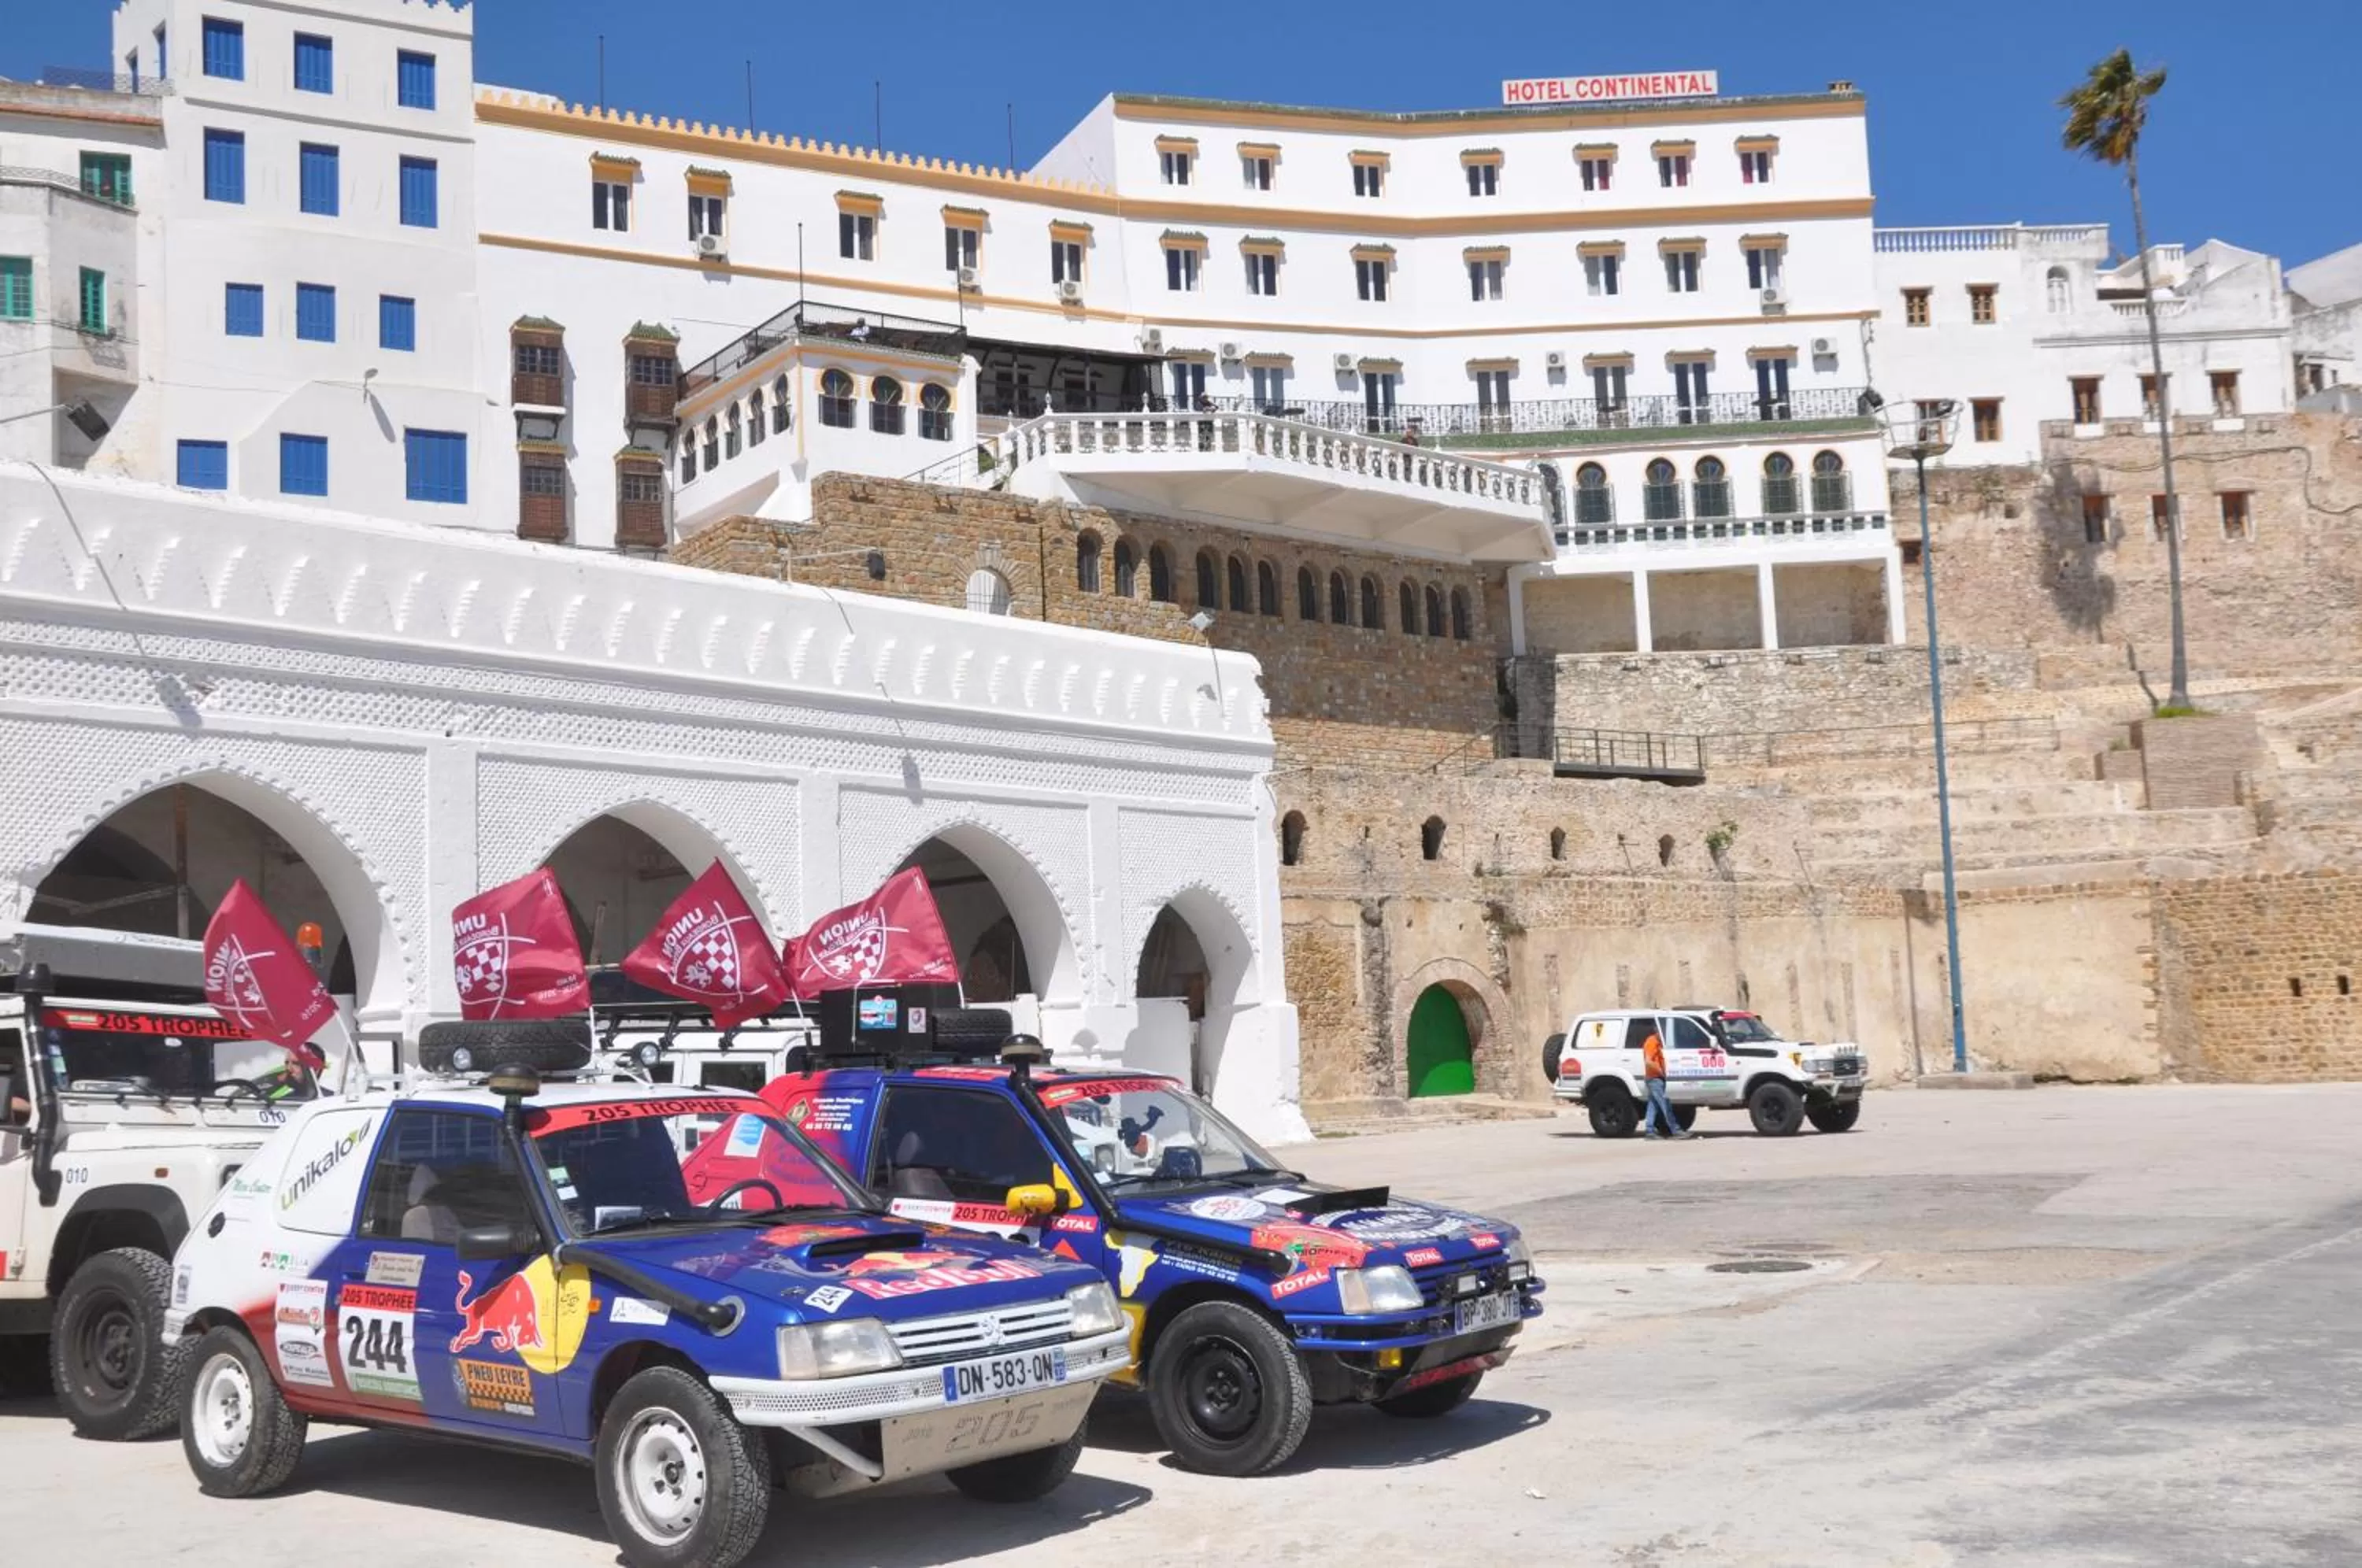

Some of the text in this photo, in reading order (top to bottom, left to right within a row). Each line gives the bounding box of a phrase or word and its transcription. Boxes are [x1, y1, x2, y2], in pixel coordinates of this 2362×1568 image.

[1507, 74, 1712, 101] HOTEL CONTINENTAL
[98, 1013, 139, 1032] 205
[259, 1110, 287, 1123] 010
[582, 1104, 631, 1122] 205
[66, 1167, 88, 1184] 010
[281, 1138, 356, 1211] unikalo
[954, 1207, 977, 1219] 205
[1407, 1249, 1440, 1266] TOTAL
[1275, 1270, 1329, 1296] TOTAL
[343, 1288, 363, 1304] 205
[810, 1287, 841, 1307] 244
[346, 1315, 407, 1373] 244
[468, 1363, 494, 1382] PNEU
[958, 1353, 1053, 1396] DN-583-QN
[945, 1401, 1044, 1453] 205
